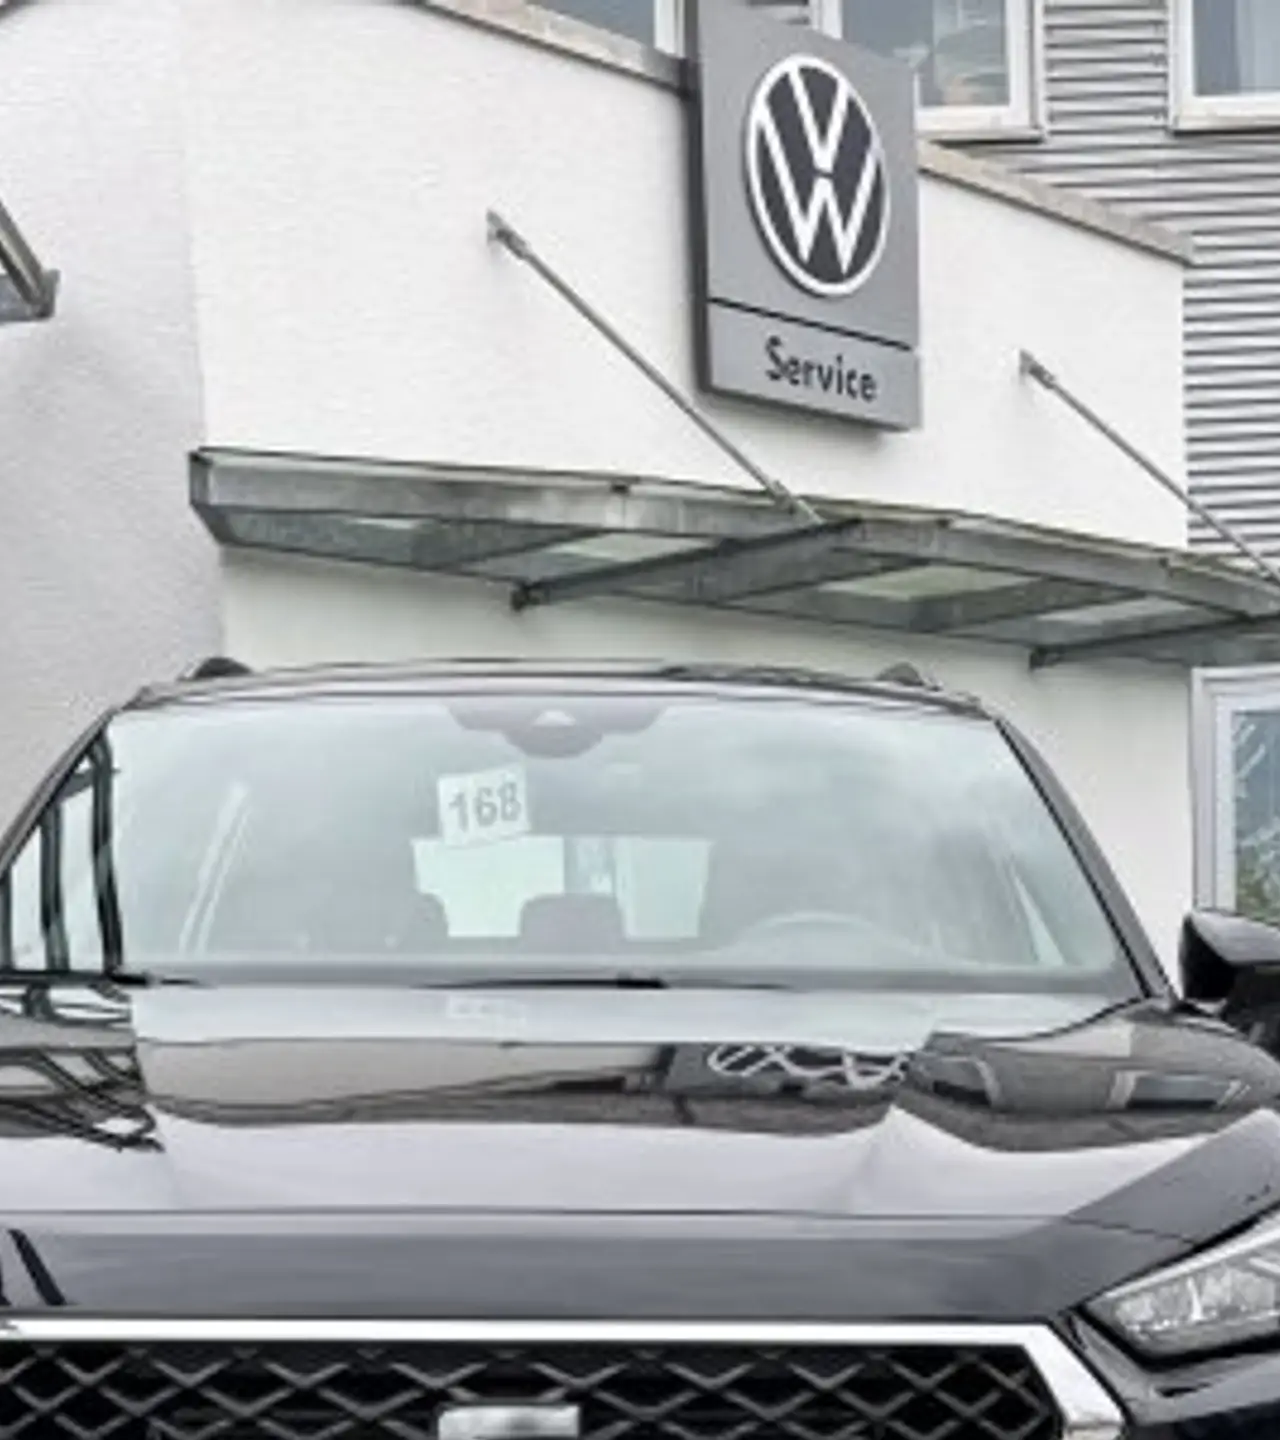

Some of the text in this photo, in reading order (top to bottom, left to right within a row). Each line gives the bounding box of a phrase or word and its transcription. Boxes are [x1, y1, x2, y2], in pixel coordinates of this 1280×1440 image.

[750, 57, 886, 288] VW
[764, 335, 879, 403] Service
[447, 781, 523, 833] 168
